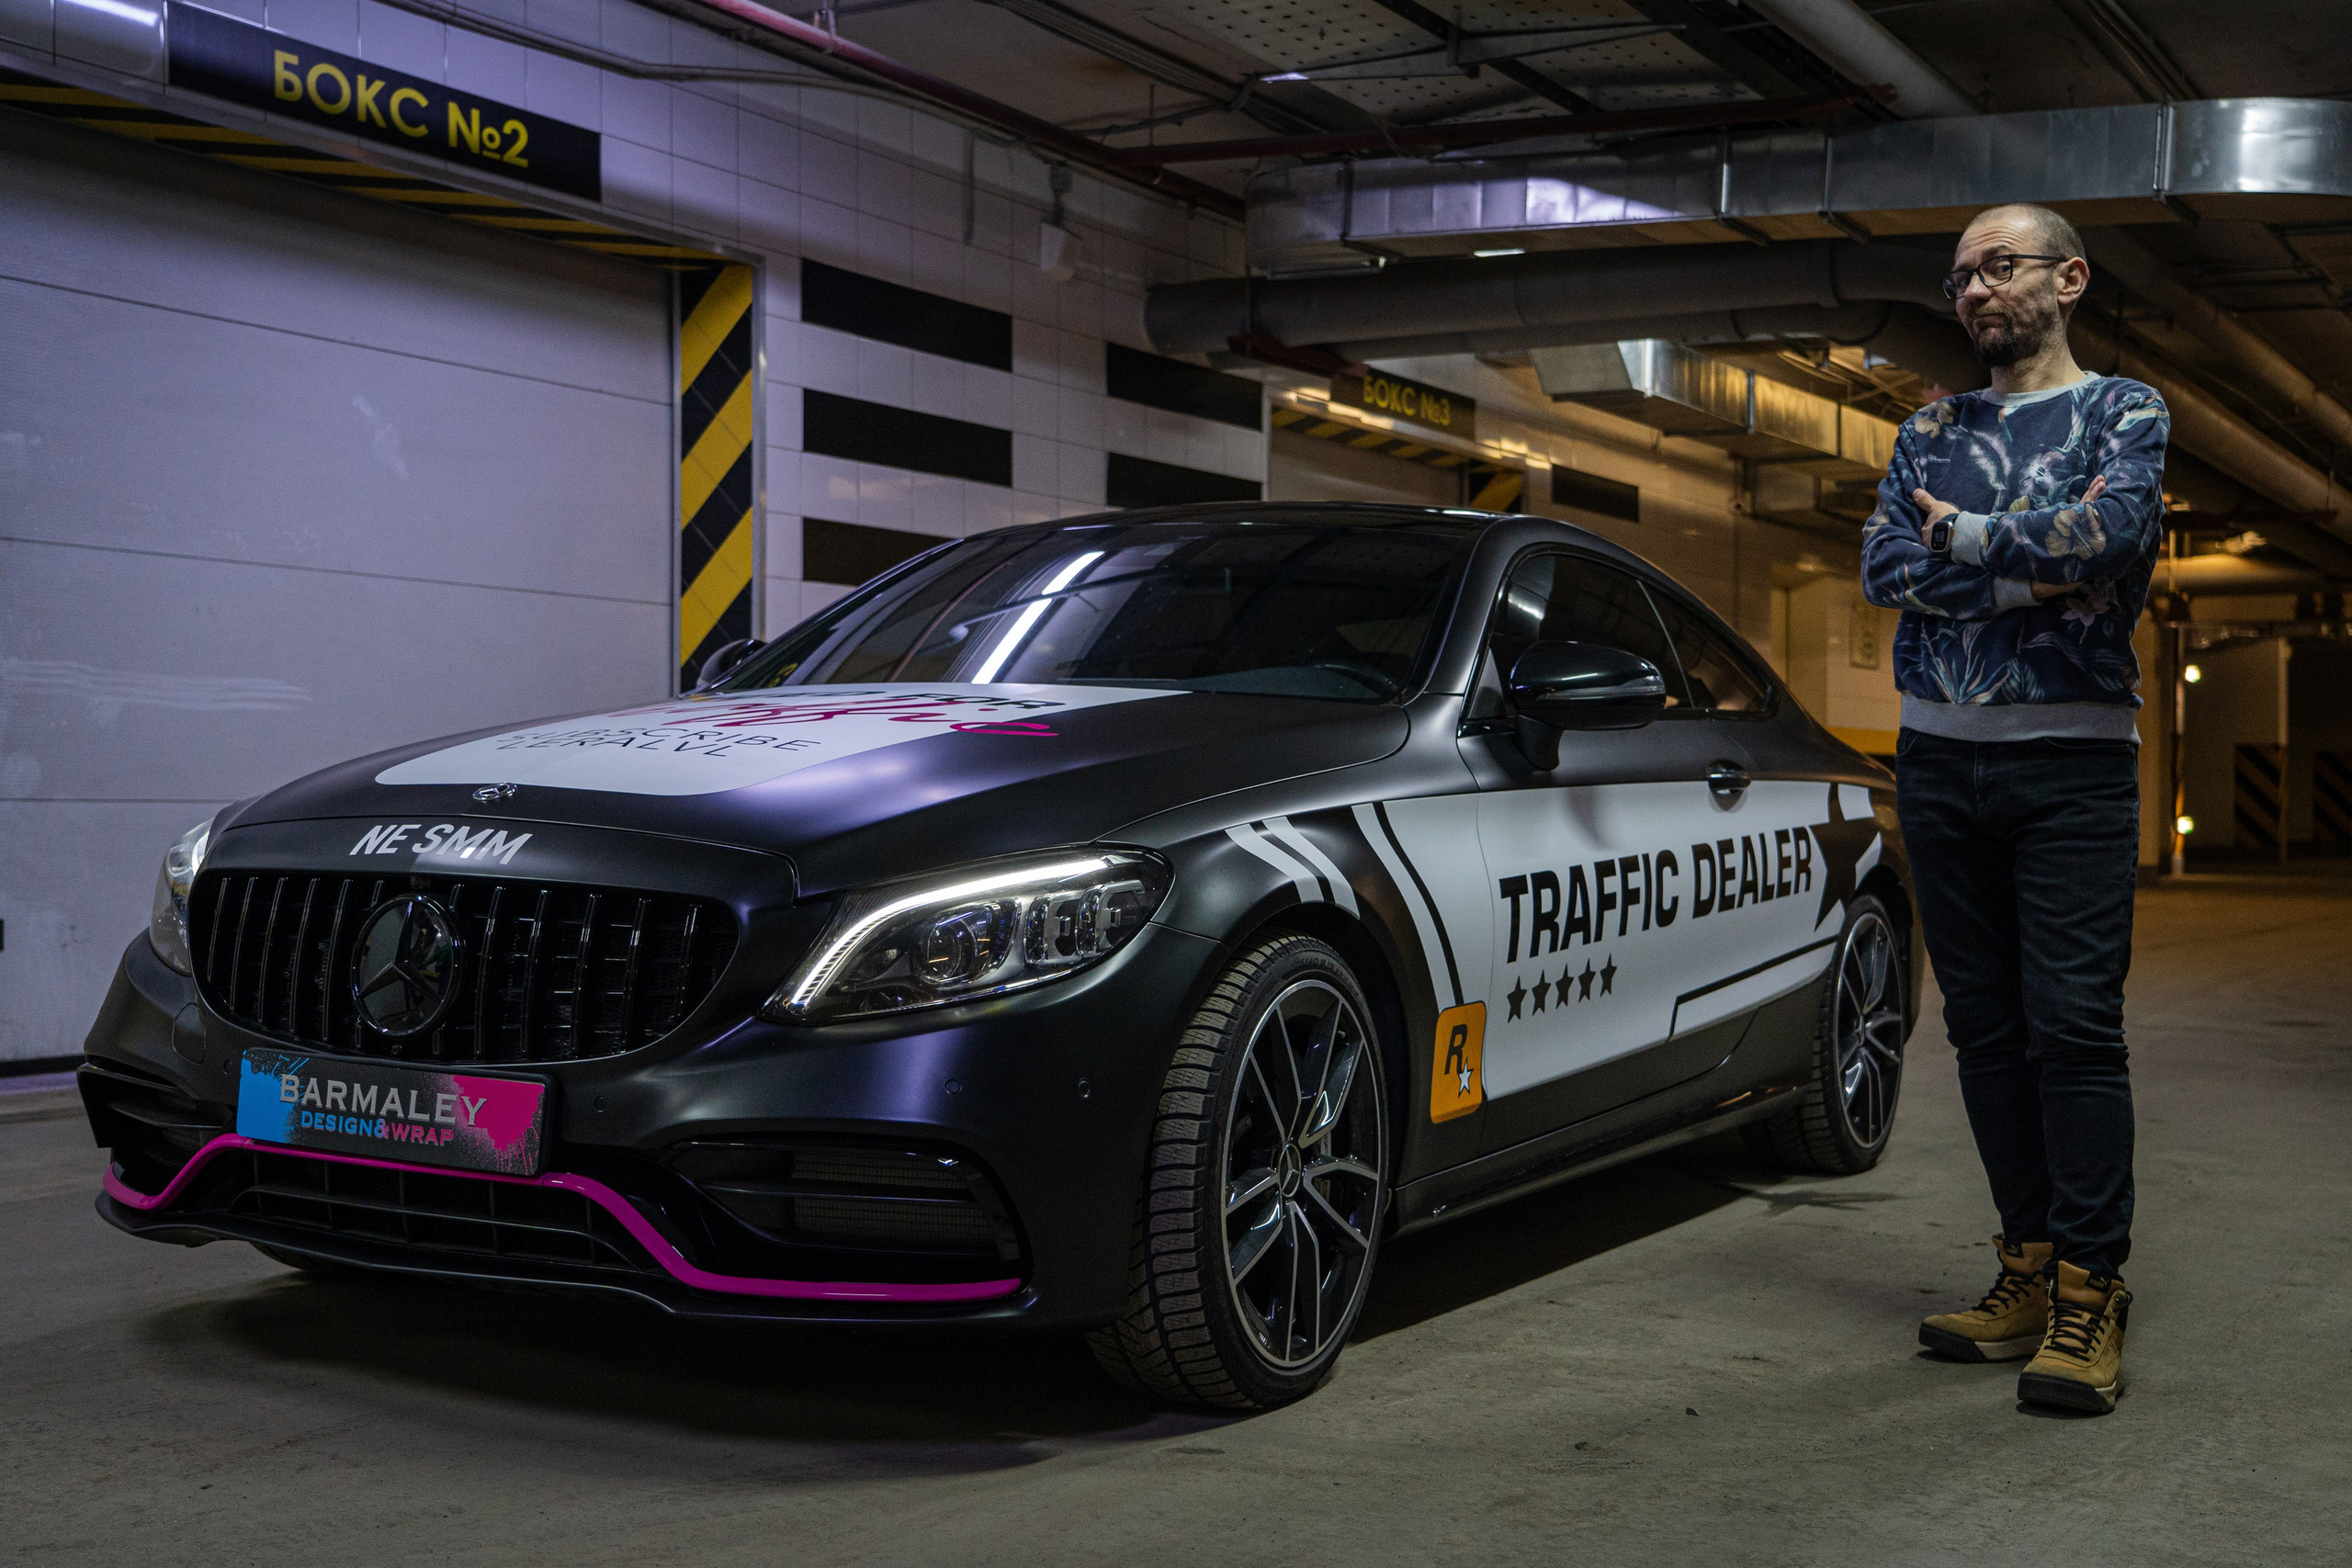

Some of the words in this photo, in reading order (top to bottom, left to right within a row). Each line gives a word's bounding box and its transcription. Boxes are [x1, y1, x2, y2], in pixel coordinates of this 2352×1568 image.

[274, 50, 429, 138] БОКС
[1363, 375, 1416, 416] БОКС
[885, 693, 1066, 709] FOR
[497, 728, 820, 751] SUBSCRIBE
[349, 824, 422, 855] NE
[412, 824, 533, 865] SMM
[1498, 850, 1679, 963] TRAFFIC
[1691, 826, 1812, 919] DEALER
[1444, 1023, 1468, 1076] R
[280, 1074, 487, 1127] BARMALEY
